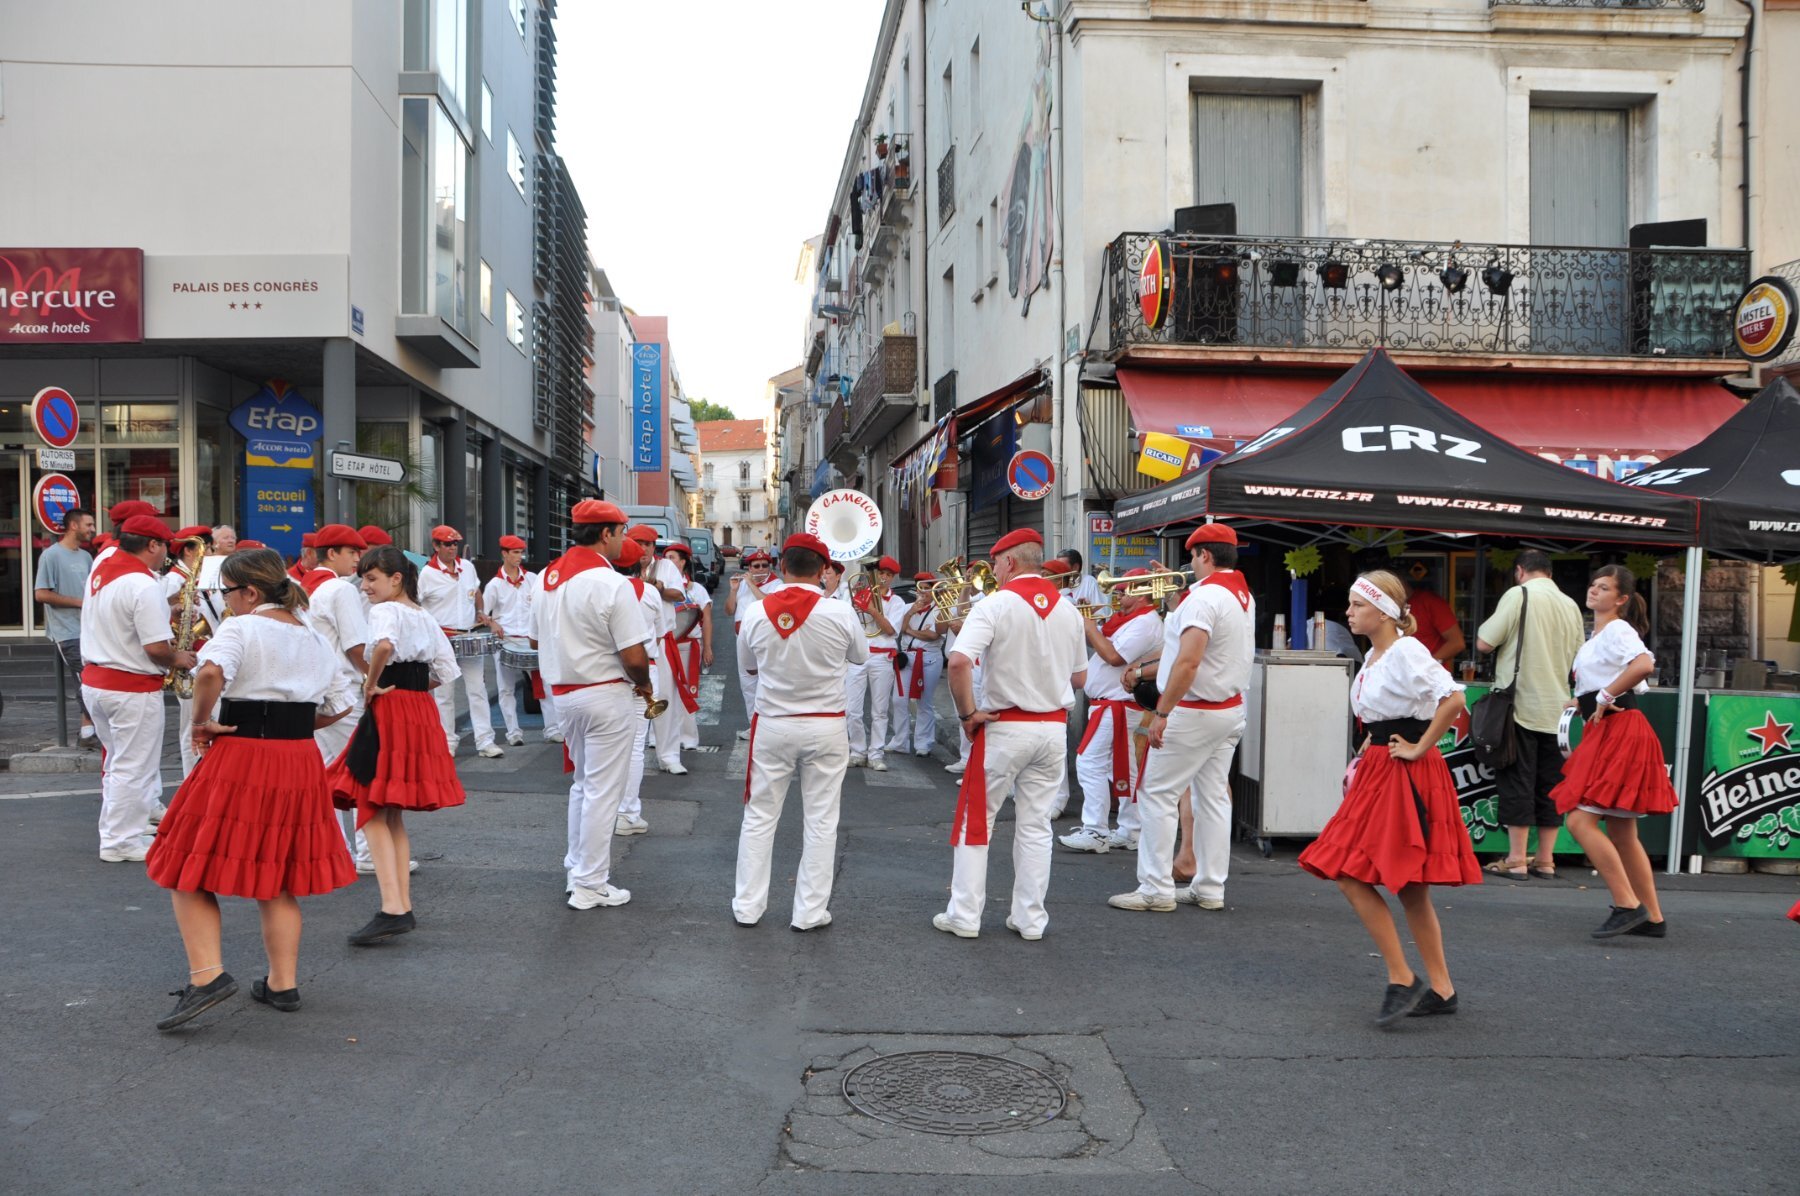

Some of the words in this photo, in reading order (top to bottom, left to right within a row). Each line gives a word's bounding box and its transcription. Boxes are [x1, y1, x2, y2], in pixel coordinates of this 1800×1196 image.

[173, 282, 219, 293] PALAIS
[223, 282, 249, 292] DES
[253, 279, 318, 292] CONGRÈS
[1739, 305, 1772, 324] AMSTEL
[51, 321, 90, 334] hotels
[1742, 321, 1765, 336] BIERE
[640, 367, 651, 414] hotel
[248, 407, 317, 436] Etap
[640, 419, 654, 463] Etap
[1342, 424, 1487, 463] CRZ
[41, 450, 74, 460] AUTORISE
[1145, 448, 1182, 466] RICARD
[49, 461, 74, 469] Minutes
[347, 460, 365, 471] ETAP
[257, 489, 305, 502] accueil
[1011, 482, 1022, 495] DE
[258, 504, 274, 512] 24h
[276, 504, 287, 512] 24
[1244, 485, 1375, 502] WWW.CRZ.FR
[1397, 495, 1523, 514] WWW.CRZ.FR
[1544, 506, 1667, 528] WWW.CRZ.FR
[808, 511, 820, 540] OUS
[823, 493, 878, 527] CAMELOUS
[828, 538, 873, 558] EZIERS
